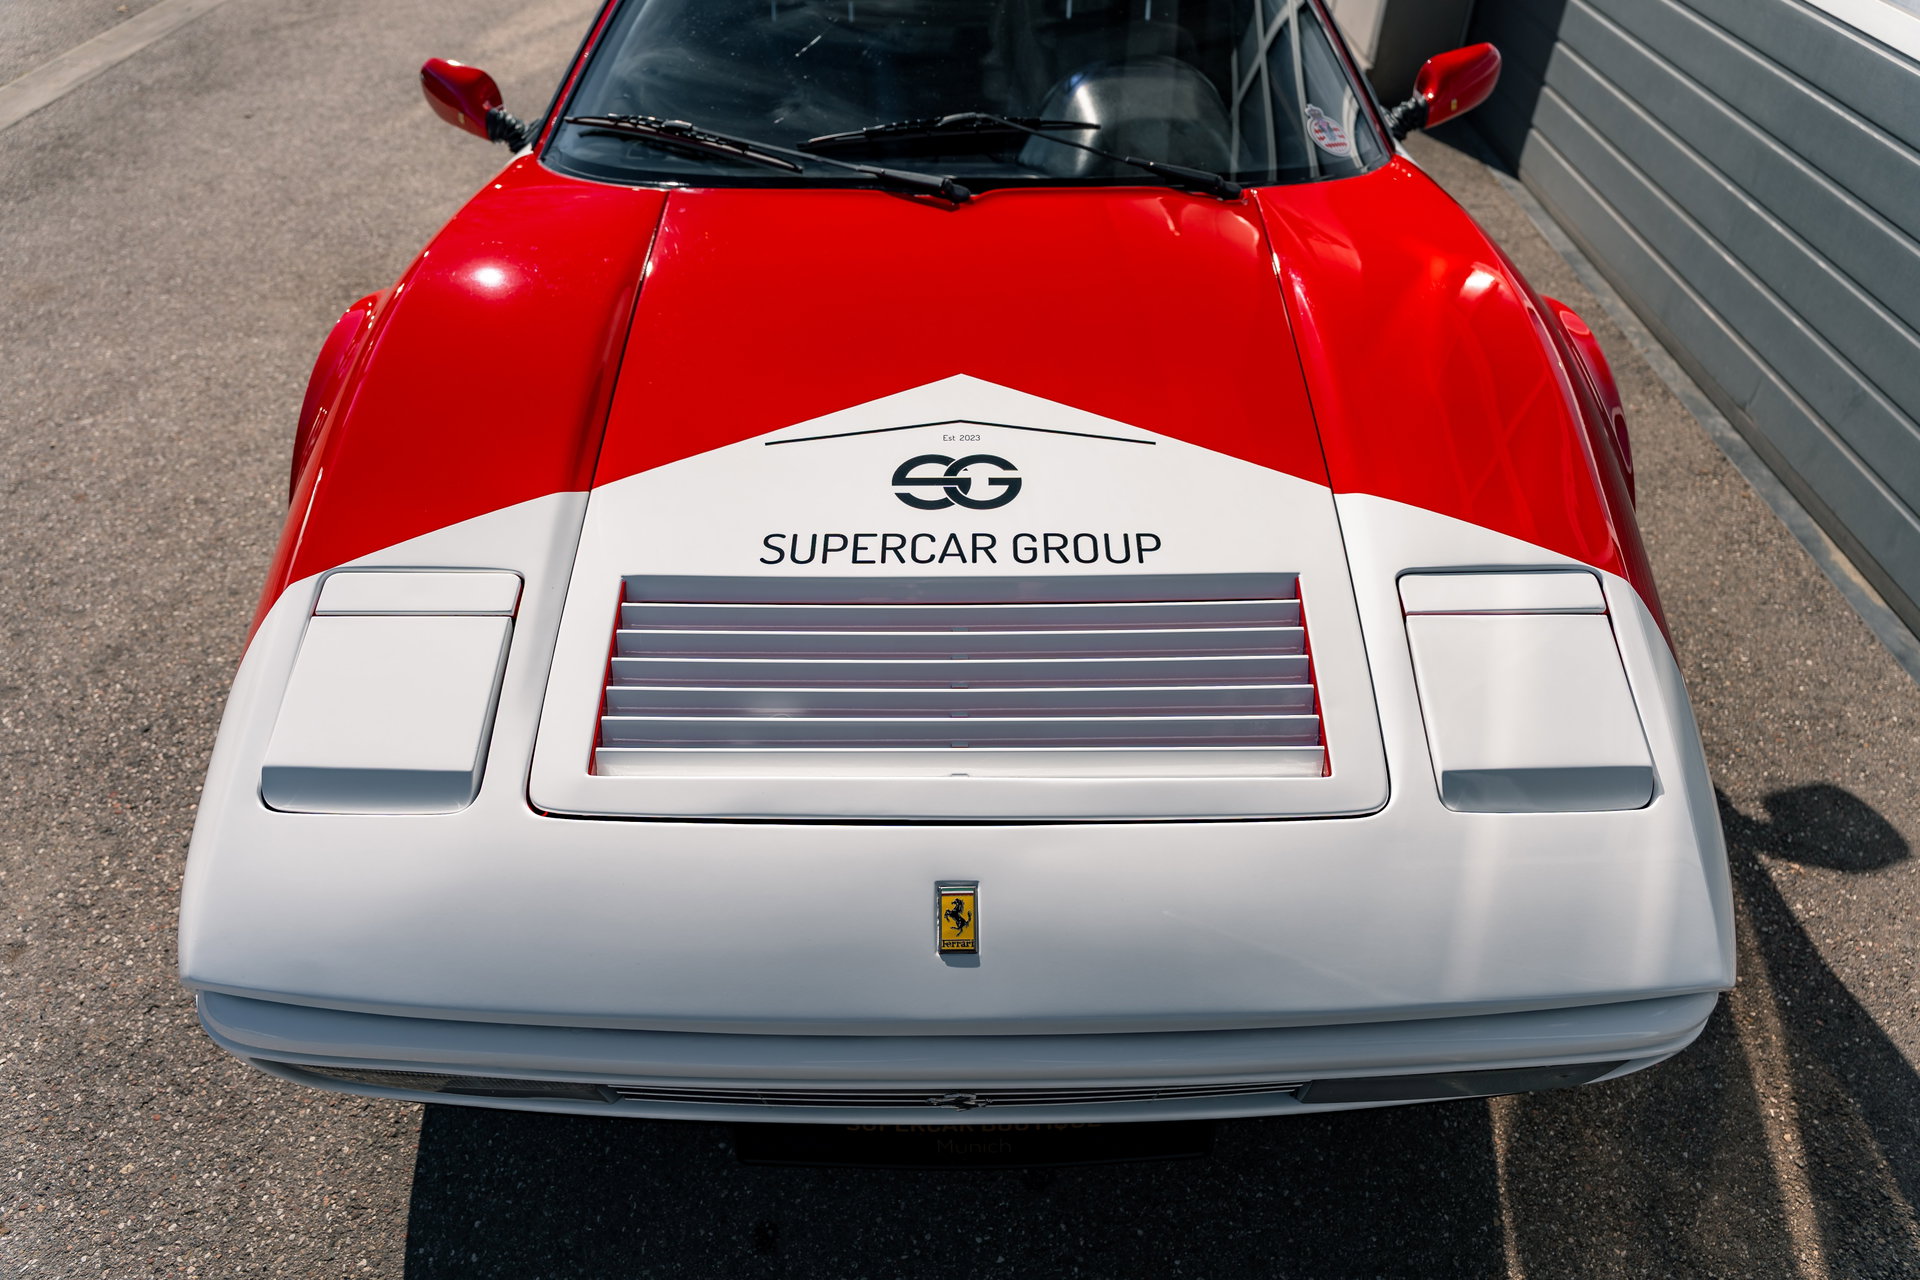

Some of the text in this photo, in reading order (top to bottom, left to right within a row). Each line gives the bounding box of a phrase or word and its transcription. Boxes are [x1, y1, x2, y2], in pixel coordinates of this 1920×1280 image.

[942, 434, 981, 442] Est 2023
[760, 533, 1161, 564] SUPERCAR GROUP
[942, 939, 975, 948] Ferrari
[937, 1138, 1012, 1154] Munich
